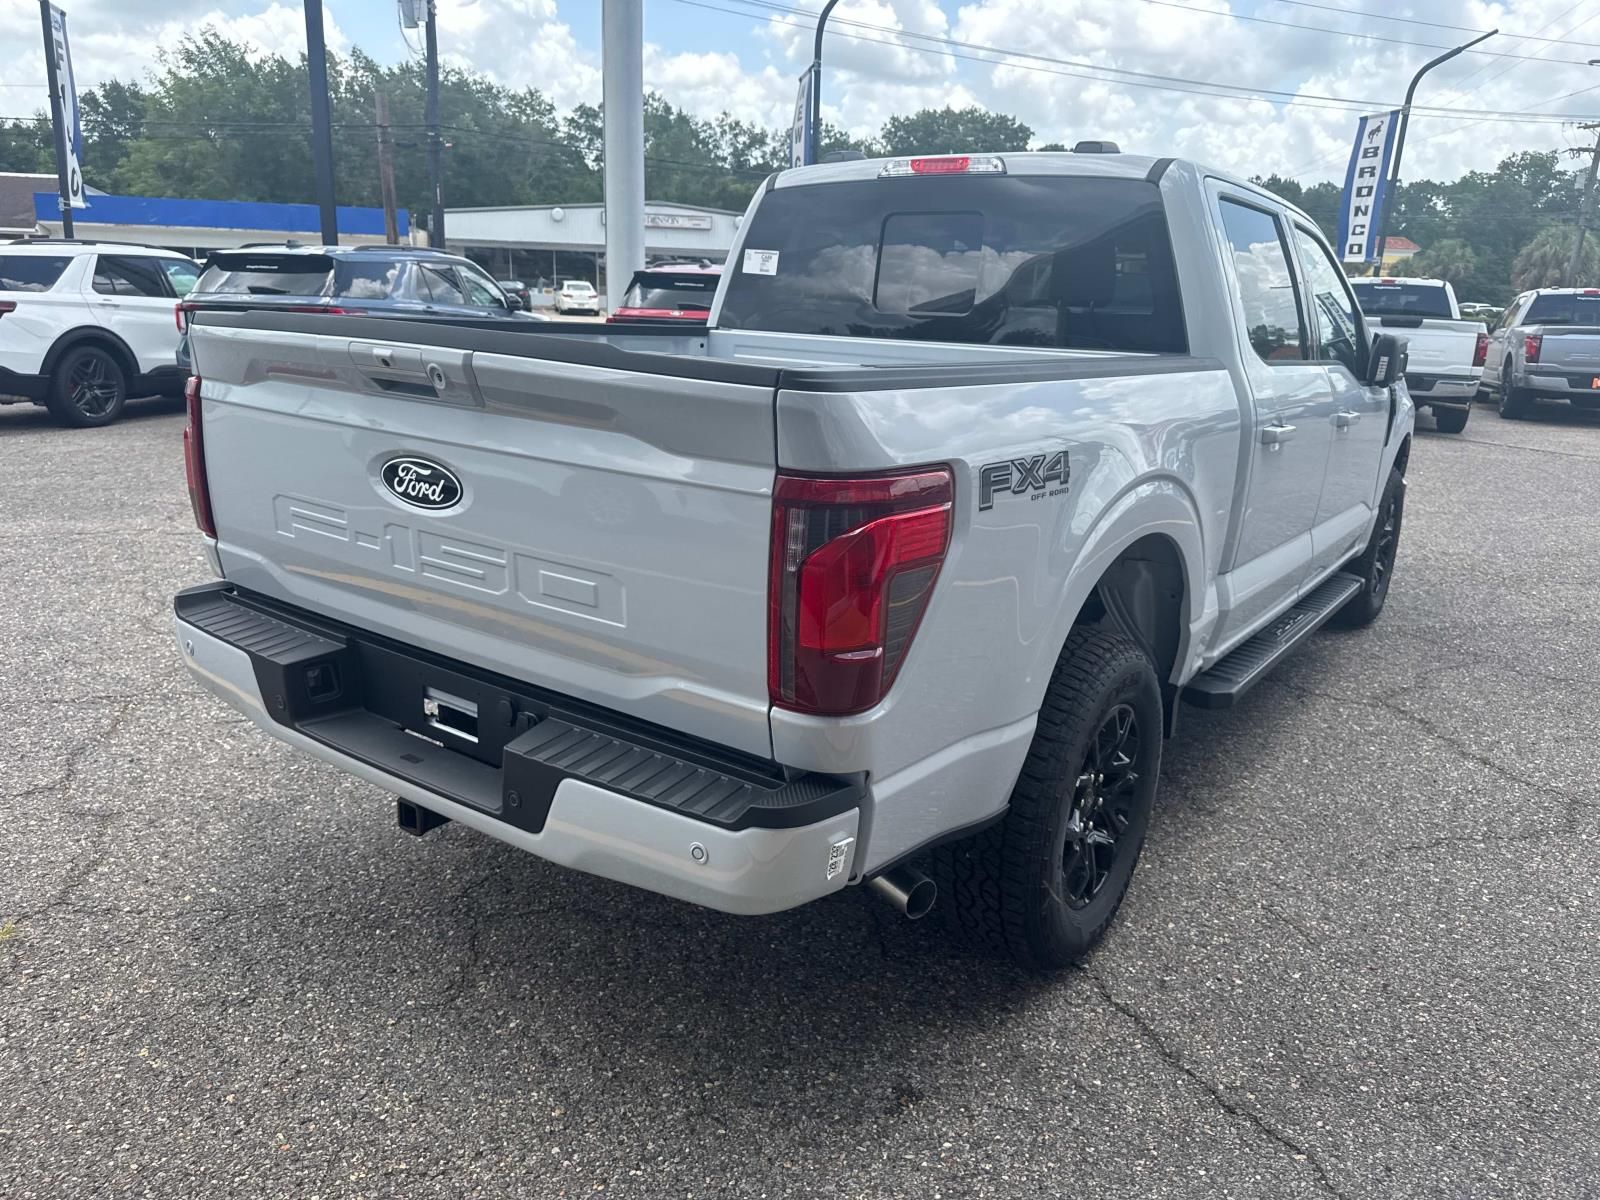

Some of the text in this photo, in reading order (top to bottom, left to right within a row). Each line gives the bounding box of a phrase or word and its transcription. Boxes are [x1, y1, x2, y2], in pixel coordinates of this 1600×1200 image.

[1349, 146, 1379, 255] BRONCO
[393, 463, 445, 502] Ford
[979, 451, 1070, 511] FX4
[1030, 487, 1069, 501] OFF ROAD
[272, 494, 627, 628] F-150
